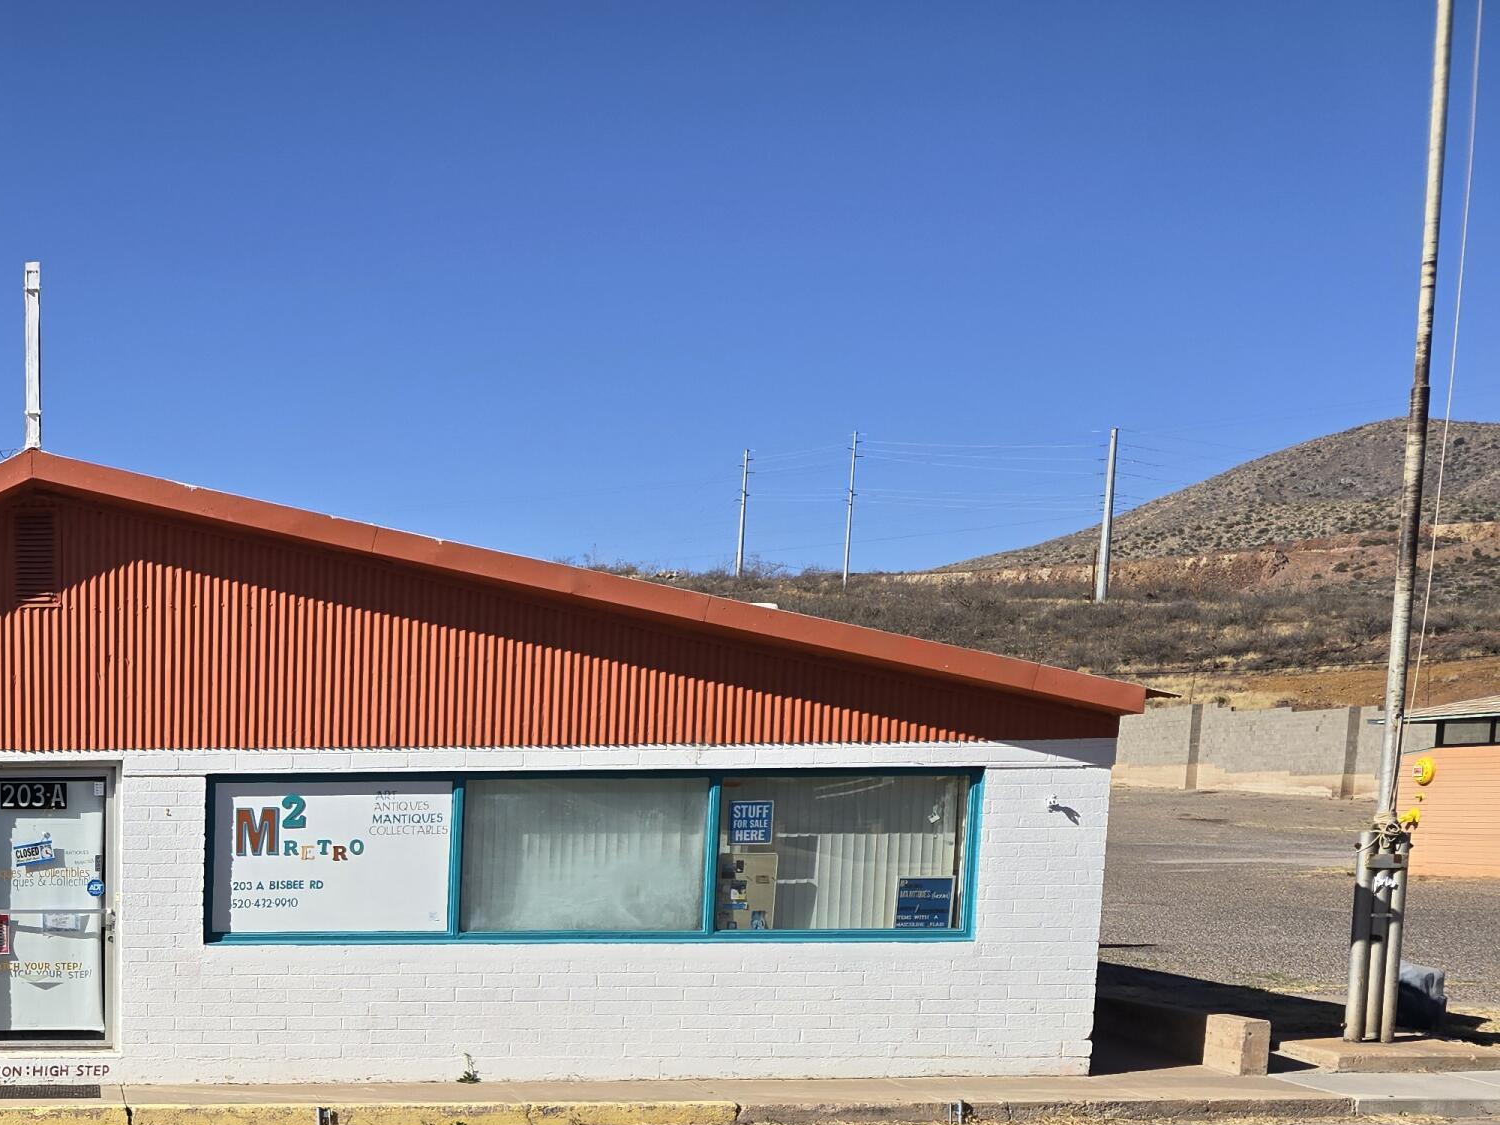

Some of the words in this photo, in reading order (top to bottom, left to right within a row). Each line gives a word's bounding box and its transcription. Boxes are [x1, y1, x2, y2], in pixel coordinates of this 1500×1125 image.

[375, 790, 398, 801] ART
[374, 801, 430, 812] ANTIQUES
[733, 805, 770, 818] STUFF
[372, 813, 444, 825] MANTIQUES
[733, 820, 748, 828] FOR
[750, 820, 768, 828] SALE
[368, 825, 449, 837] COLLECTABLES
[735, 830, 765, 841] HERE
[15, 846, 40, 859] CLOSED
[284, 838, 365, 862] RETRO
[233, 881, 253, 891] 203
[256, 881, 265, 891] A
[269, 880, 304, 890] BISBEE
[309, 880, 324, 890] RD
[25, 962, 50, 971] YOUR
[55, 962, 83, 971] STEP!
[76, 1065, 110, 1076] STEP
